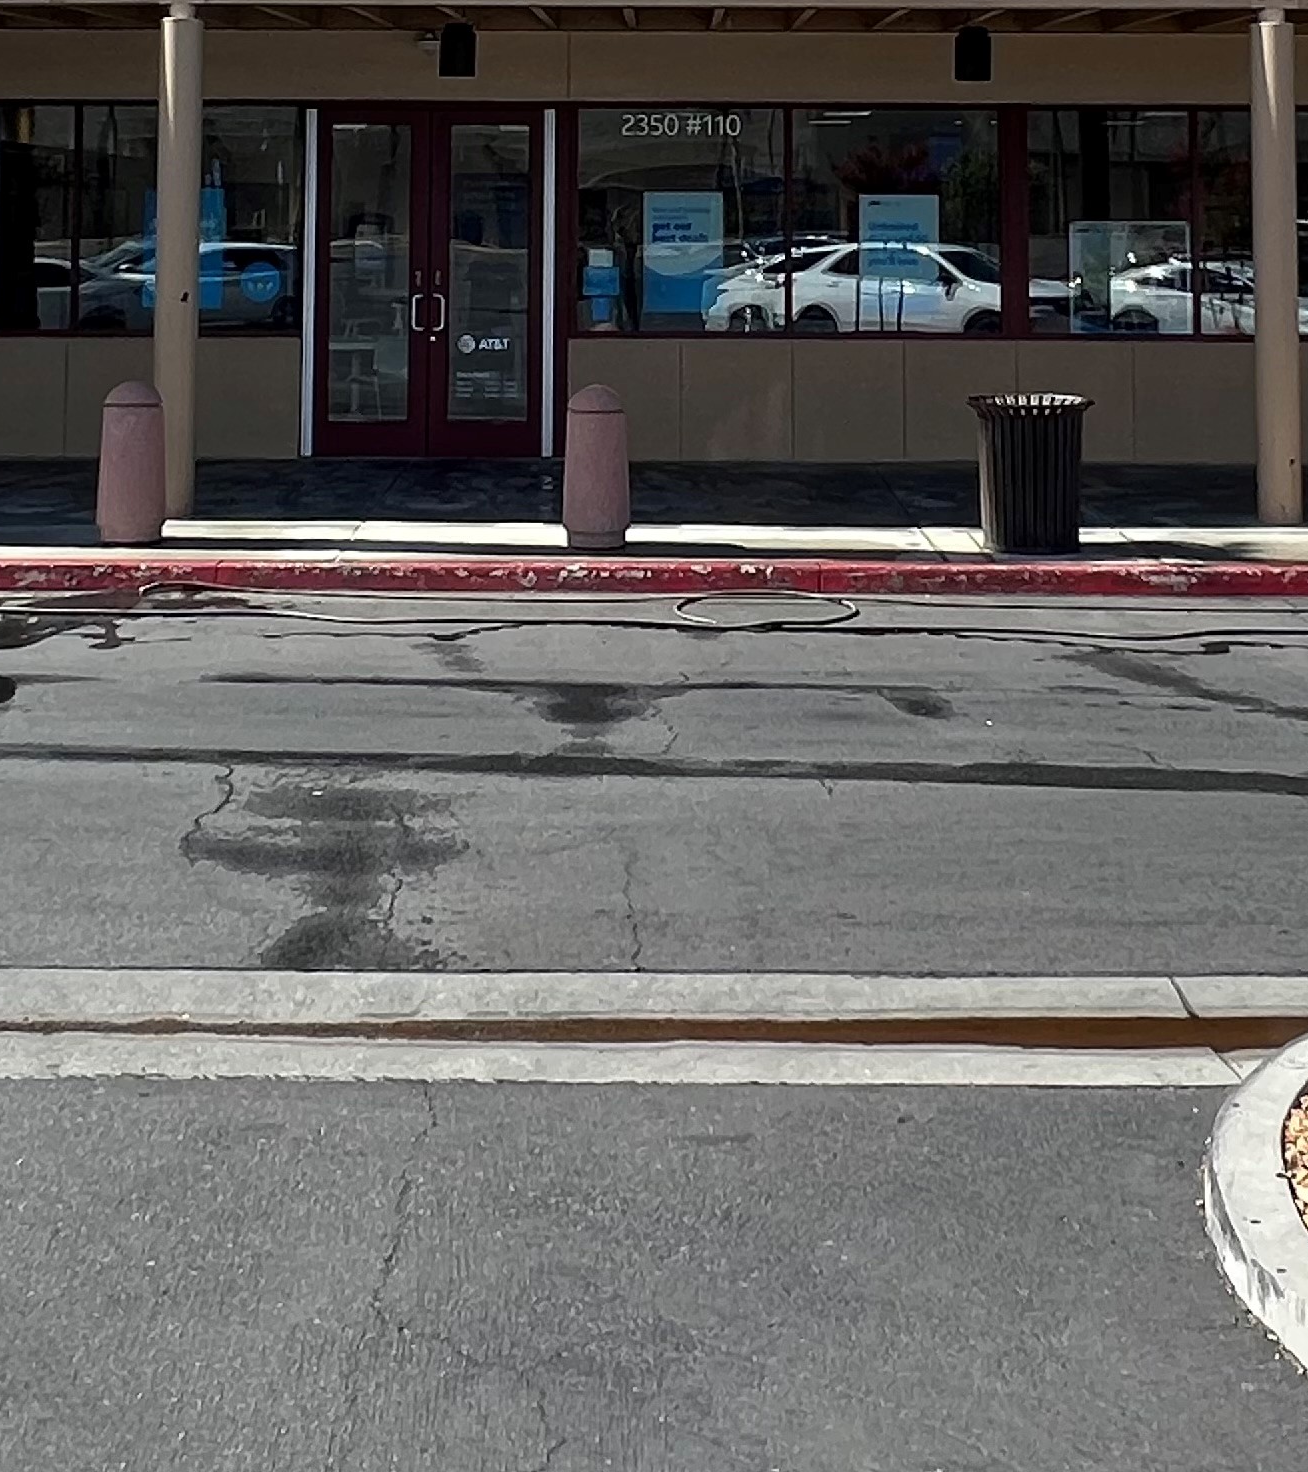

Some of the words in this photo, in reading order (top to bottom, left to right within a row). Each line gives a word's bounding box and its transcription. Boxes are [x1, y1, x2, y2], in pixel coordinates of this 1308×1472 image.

[621, 113, 680, 136] 2350
[685, 112, 742, 136] #110
[477, 337, 511, 350] AT&T
